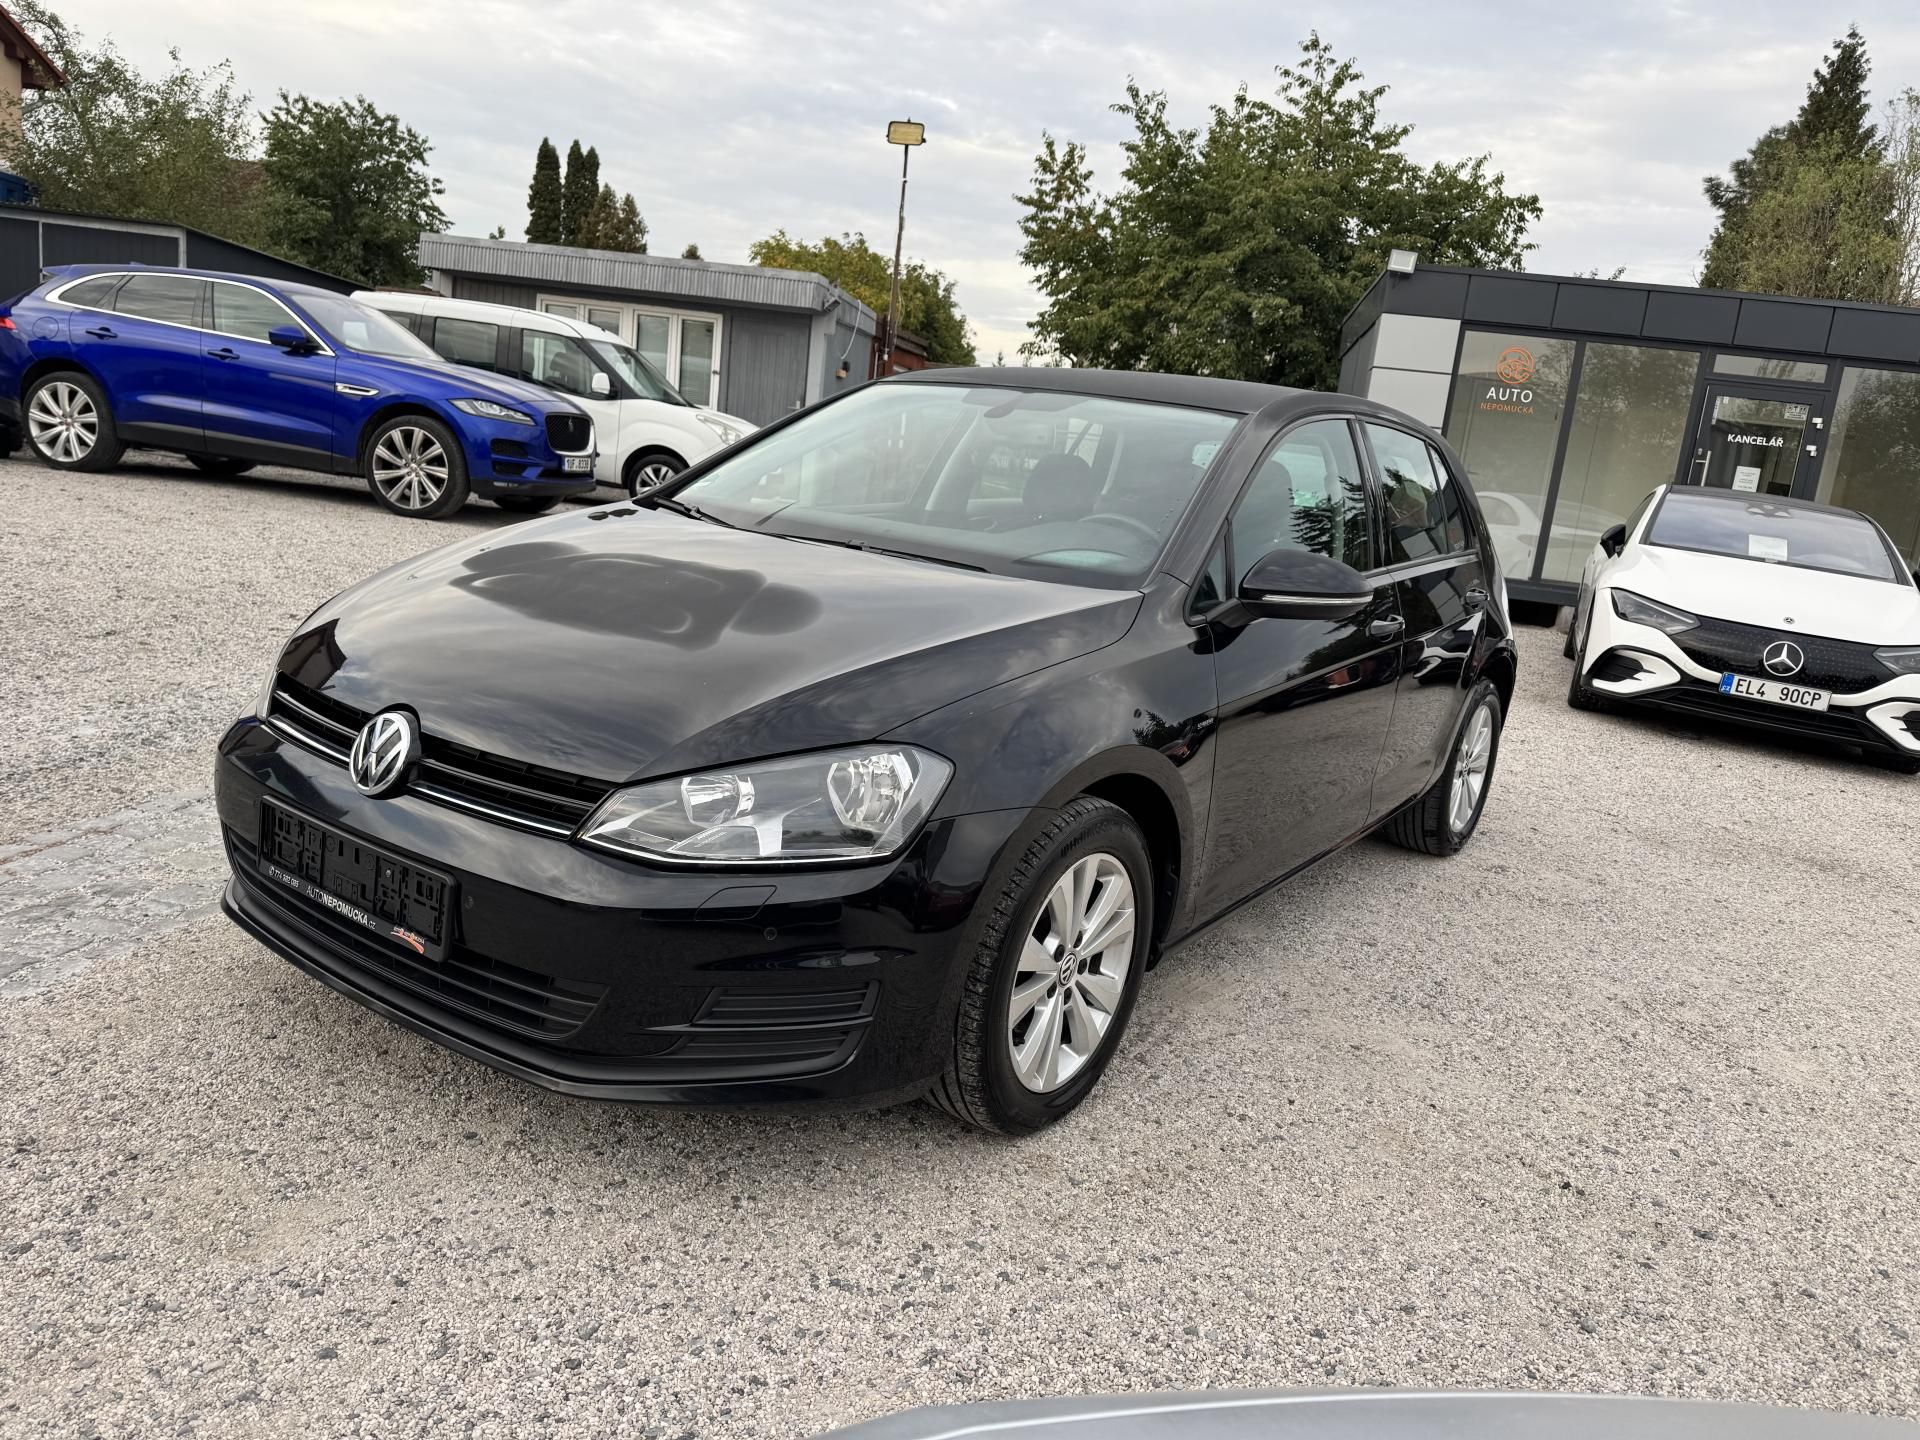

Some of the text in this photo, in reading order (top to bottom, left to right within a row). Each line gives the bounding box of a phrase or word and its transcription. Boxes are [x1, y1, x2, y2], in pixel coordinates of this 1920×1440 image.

[1486, 386, 1533, 403] AUTO
[1727, 433, 1784, 448] KANCELÁŘ
[1735, 678, 1822, 707] EL4 90CP
